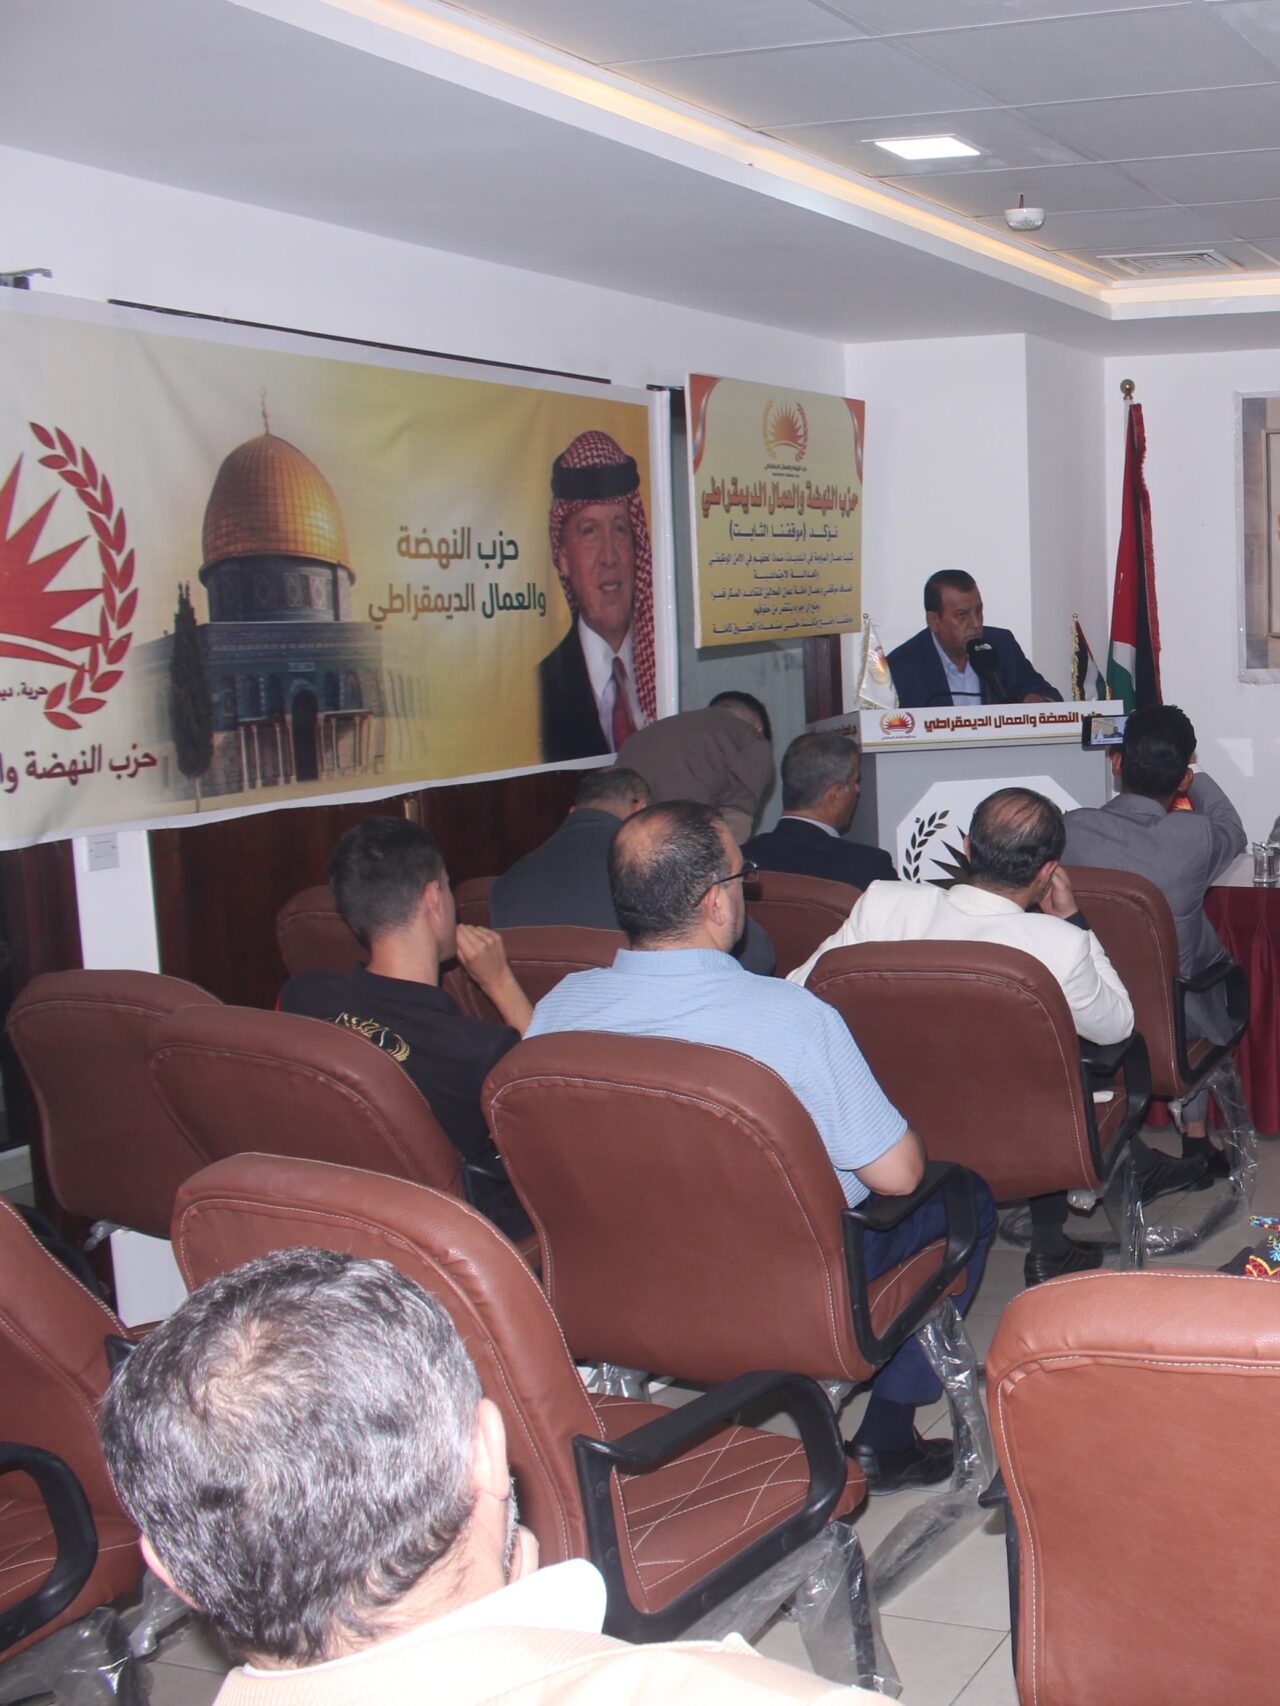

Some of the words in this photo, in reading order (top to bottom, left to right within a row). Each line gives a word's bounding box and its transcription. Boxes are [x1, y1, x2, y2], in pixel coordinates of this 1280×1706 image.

[806, 480, 838, 516] النهضة
[839, 486, 858, 517] حزب
[396, 525, 472, 570] النهضة
[477, 530, 520, 570] حزب
[368, 582, 475, 630] الديمقراطي
[481, 582, 546, 619] والعمال
[923, 715, 992, 733] الديمقراطي
[994, 713, 1037, 728] والعمال
[1038, 711, 1079, 724] النهضة
[24, 743, 103, 786] النهضة
[108, 743, 158, 780] حزب
